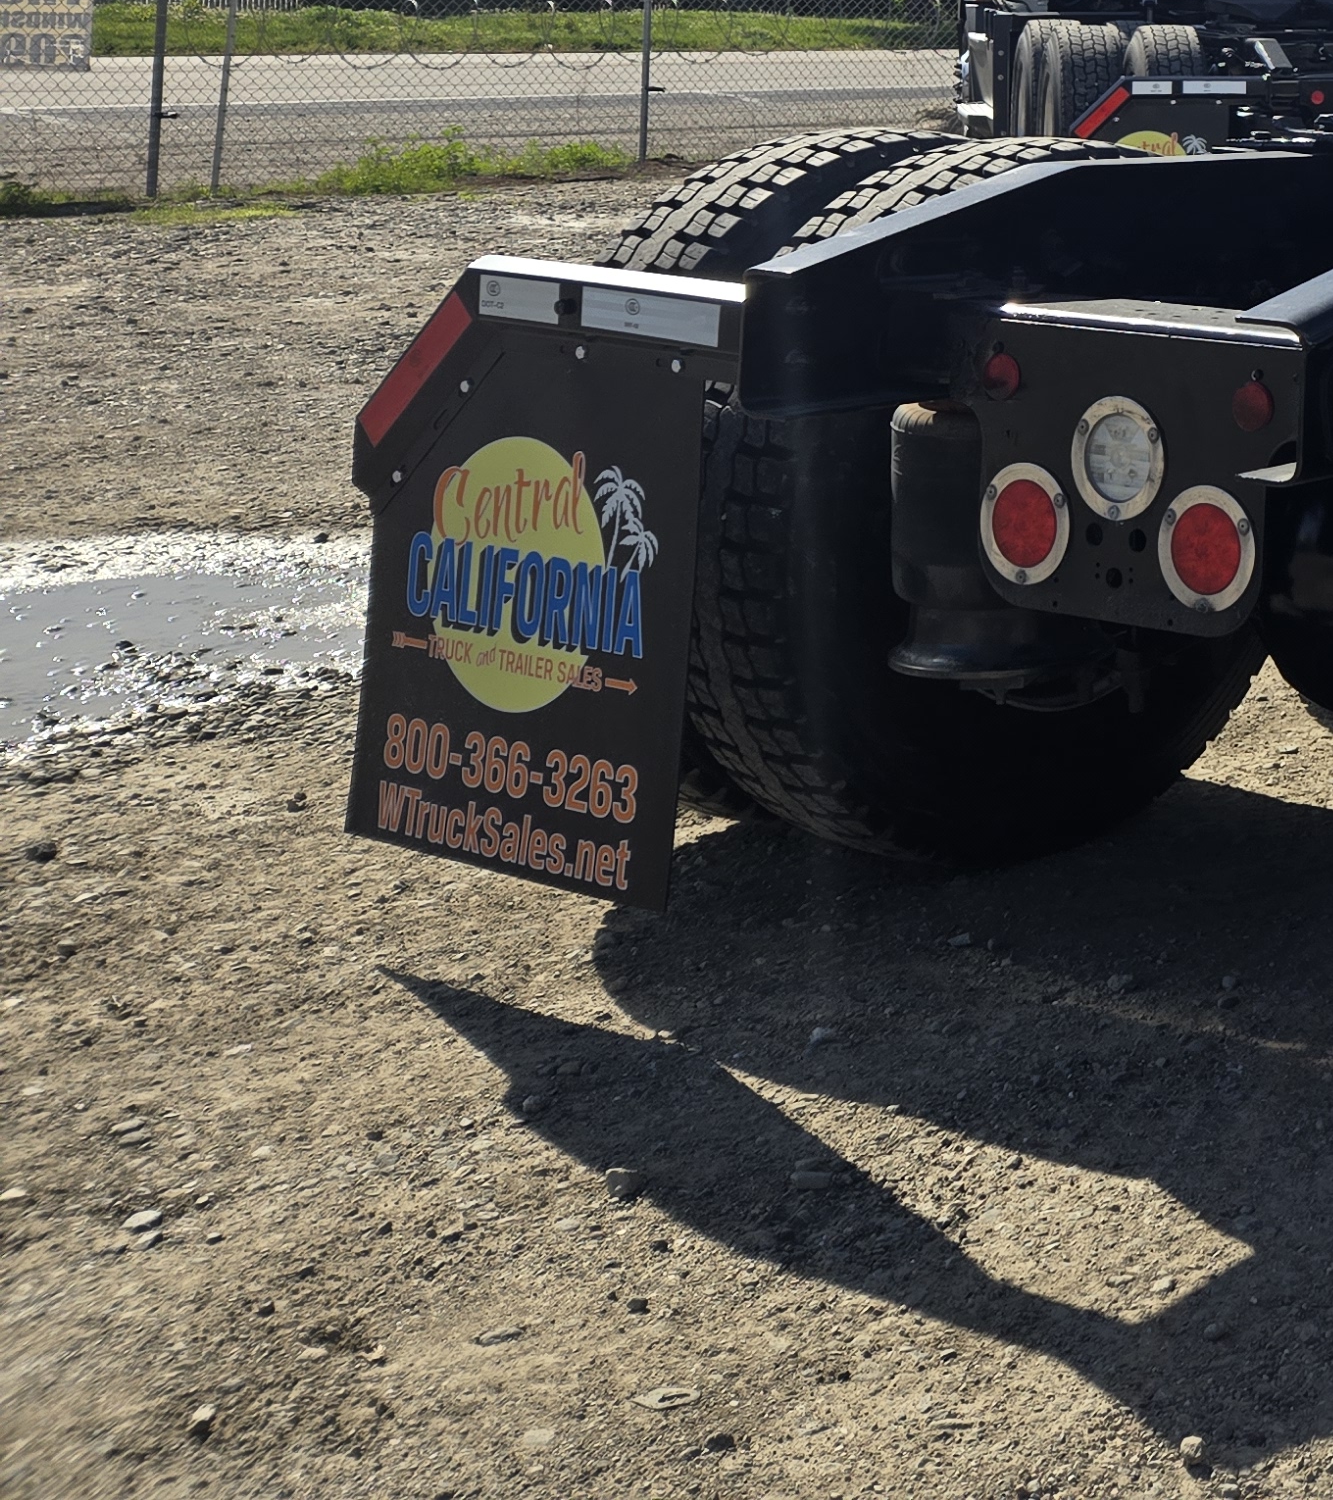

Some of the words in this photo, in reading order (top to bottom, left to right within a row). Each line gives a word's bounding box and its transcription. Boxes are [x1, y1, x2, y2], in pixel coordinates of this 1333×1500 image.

[433, 451, 586, 546] Central
[406, 531, 643, 659] CALIFORNIA
[427, 635, 474, 664] TRUCK
[476, 643, 496, 667] and
[499, 649, 553, 682] TRAILER
[557, 661, 603, 693] SALES
[383, 713, 639, 824] 800-366-3263
[377, 780, 631, 891] WTruckSales.net
